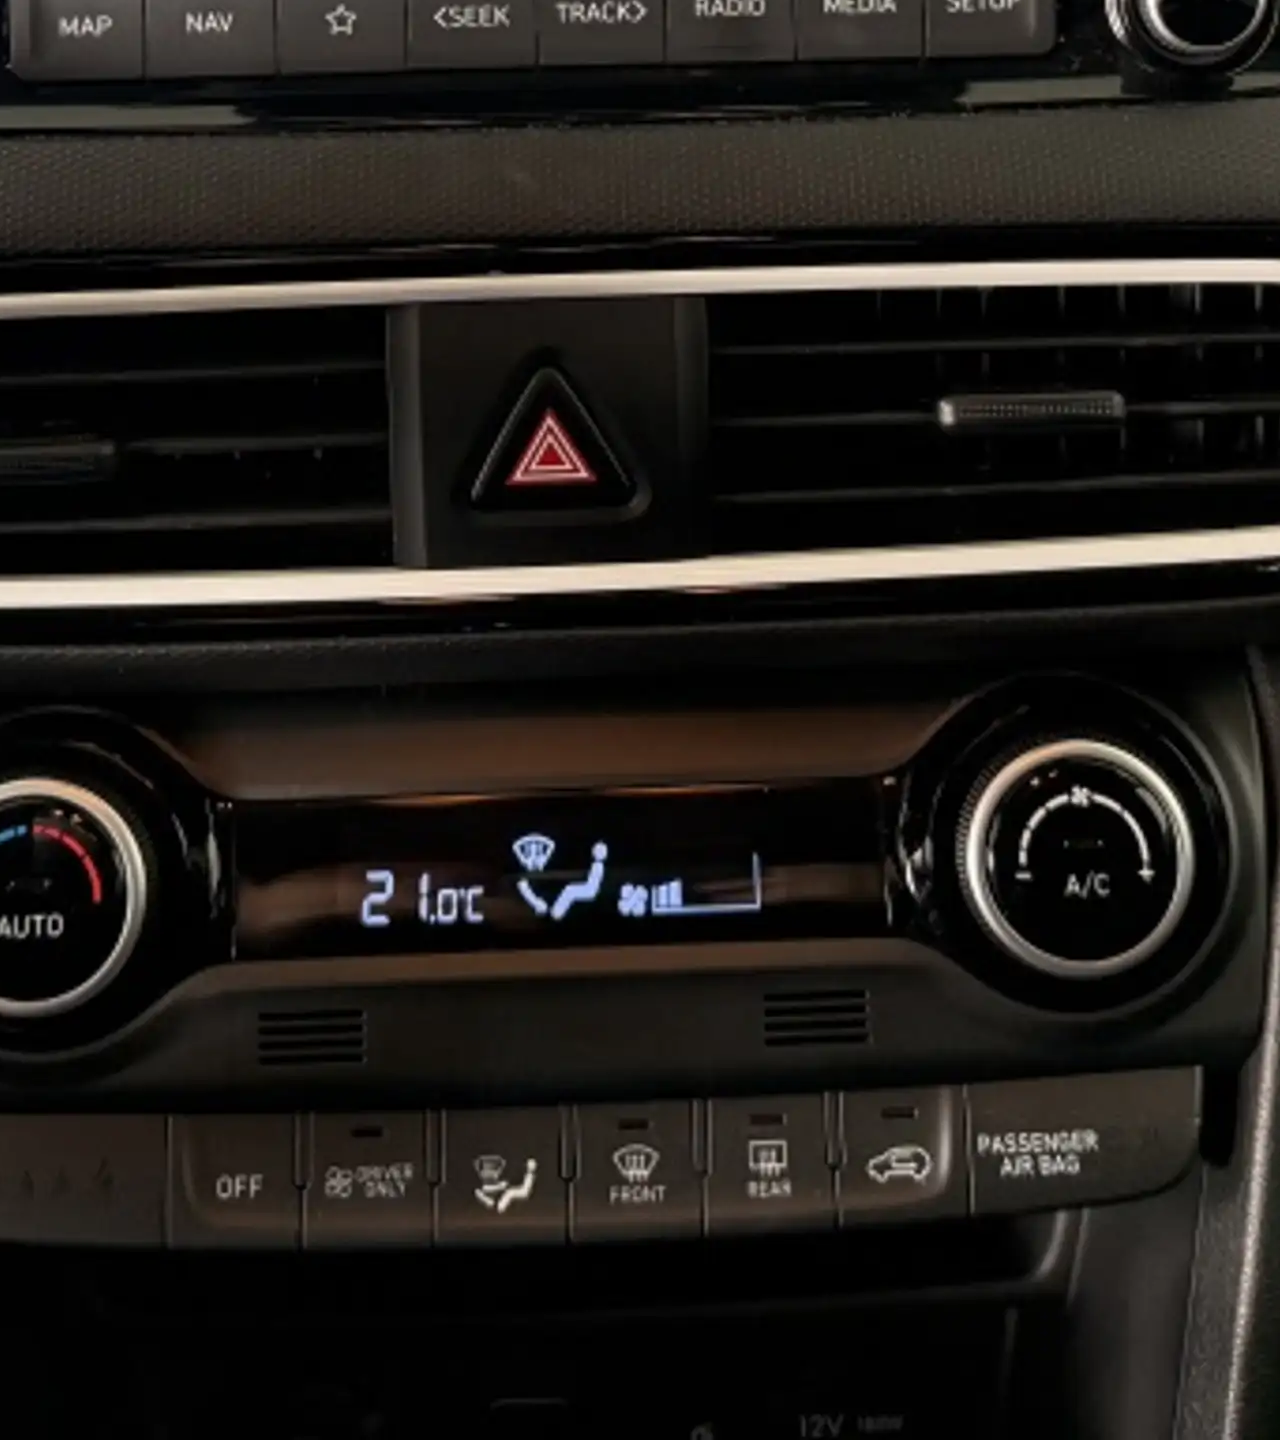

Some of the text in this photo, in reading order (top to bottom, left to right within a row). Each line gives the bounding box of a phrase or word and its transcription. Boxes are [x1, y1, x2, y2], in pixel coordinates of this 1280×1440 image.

[58, 15, 112, 37] MAP
[186, 13, 233, 33] NAV
[1064, 871, 1110, 899] A/C
[977, 1129, 1099, 1155] PASSENGER
[355, 1163, 414, 1182] DRIVER
[1000, 1153, 1080, 1178] AIR BAG
[216, 1174, 263, 1199] OFF
[365, 1179, 406, 1197] ONLY
[609, 1185, 666, 1203] FRONT
[747, 1180, 792, 1198] REAR
[798, 1413, 845, 1438] 12V
